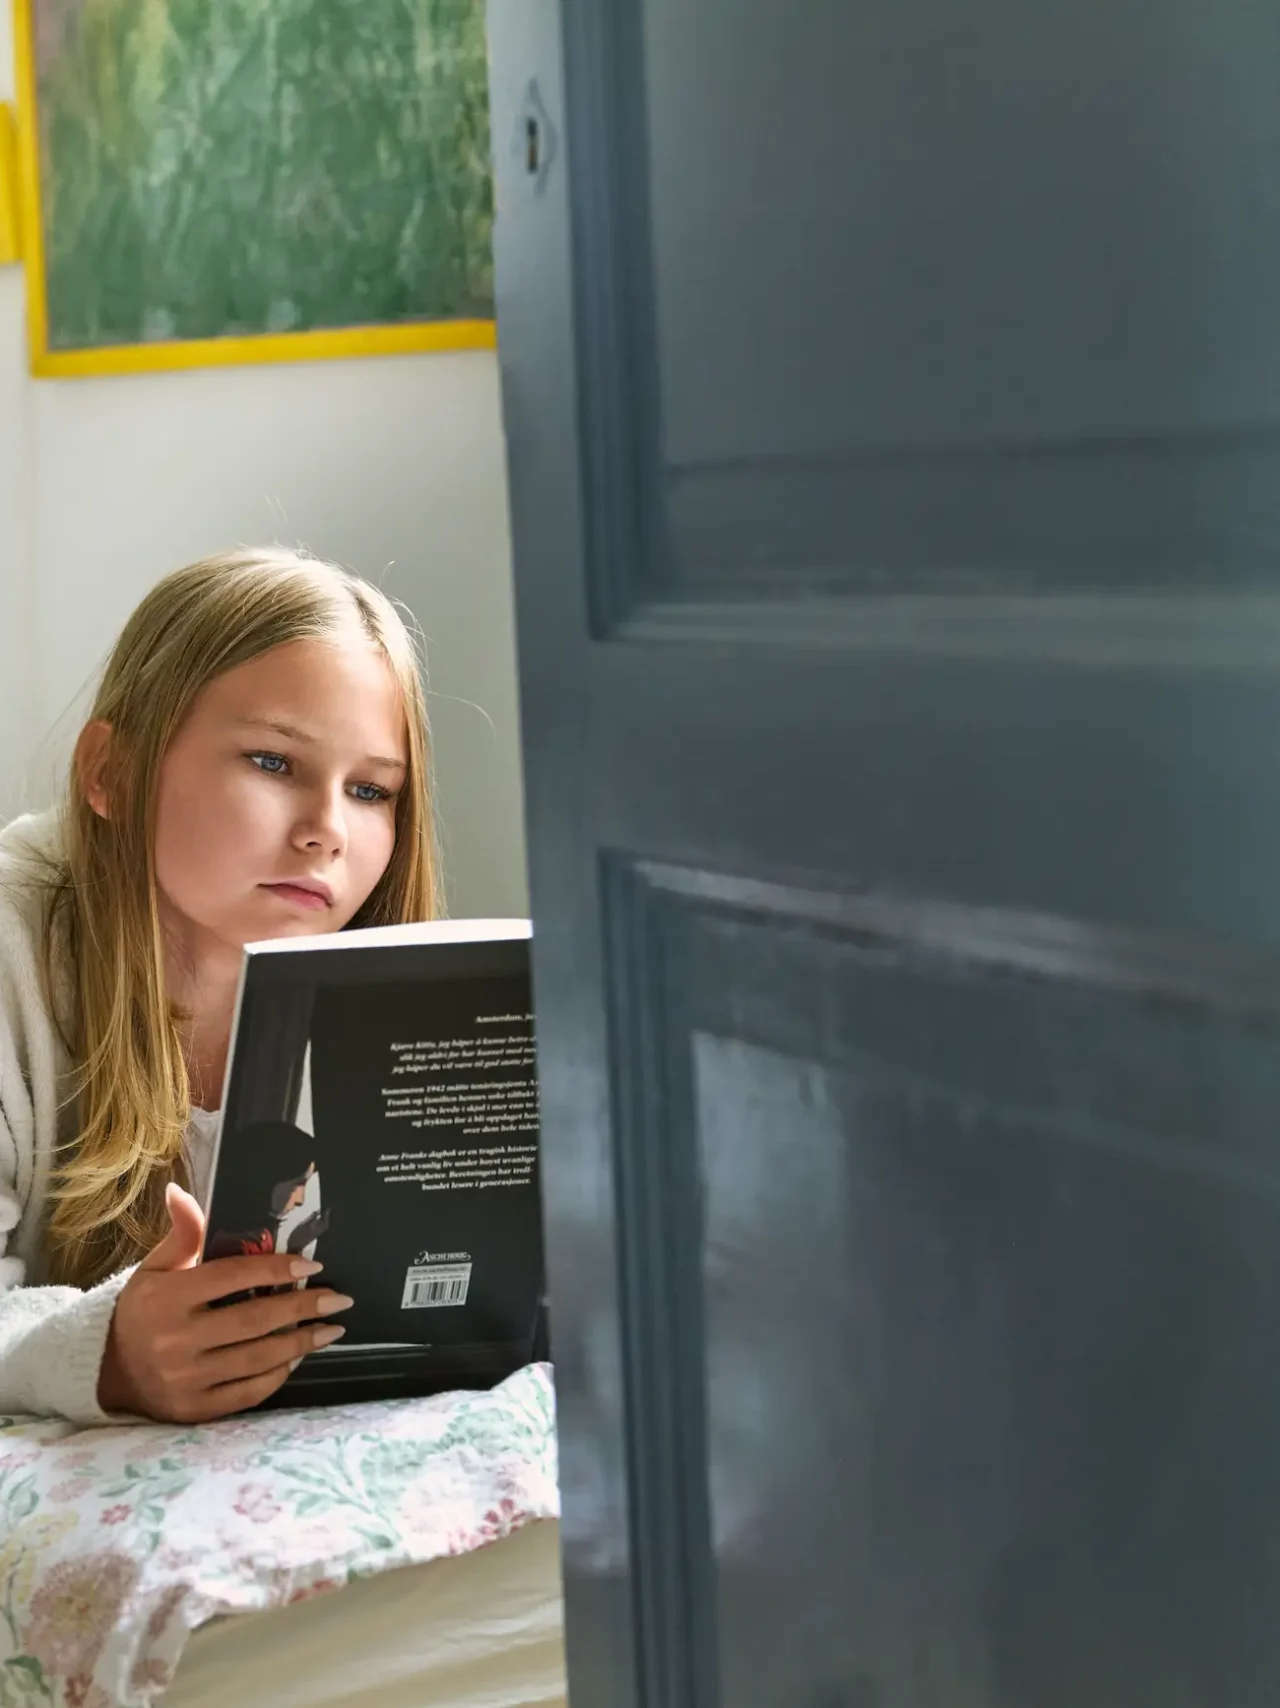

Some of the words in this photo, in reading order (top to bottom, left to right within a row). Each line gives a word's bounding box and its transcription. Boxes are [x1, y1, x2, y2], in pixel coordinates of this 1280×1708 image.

[381, 1087, 424, 1096] Sommeren
[426, 1084, 445, 1093] 1942
[387, 1098, 410, 1107] Frank
[412, 1098, 422, 1106] og
[424, 1095, 457, 1104] familien
[458, 1094, 486, 1102] hennes
[506, 1090, 534, 1099] tilflukt
[426, 1107, 438, 1115] De
[439, 1105, 460, 1115] levde
[466, 1103, 485, 1113] skjul
[412, 1120, 422, 1128] og
[424, 1117, 453, 1128] frykten
[453, 1116, 466, 1124] for
[474, 1114, 485, 1122] bli
[486, 1112, 522, 1123] oppdaget
[481, 1125, 499, 1133] dem
[500, 1124, 516, 1132] hele
[379, 1154, 400, 1162] Anne
[400, 1151, 427, 1160] Franks
[427, 1149, 456, 1159] dagbok
[478, 1145, 505, 1155] tragisk
[507, 1144, 538, 1153] historie
[400, 1161, 416, 1170] helt
[417, 1160, 441, 1170] vanlig
[442, 1159, 453, 1168] liv
[454, 1158, 478, 1167] under
[502, 1155, 536, 1164] uvanlige
[384, 1171, 447, 1182] omstendigheter.
[448, 1168, 497, 1178] Beretningen
[498, 1167, 512, 1175] har
[422, 1181, 450, 1190] bundet
[451, 1180, 474, 1189] lesere
[479, 1177, 531, 1189] generasjoner.
